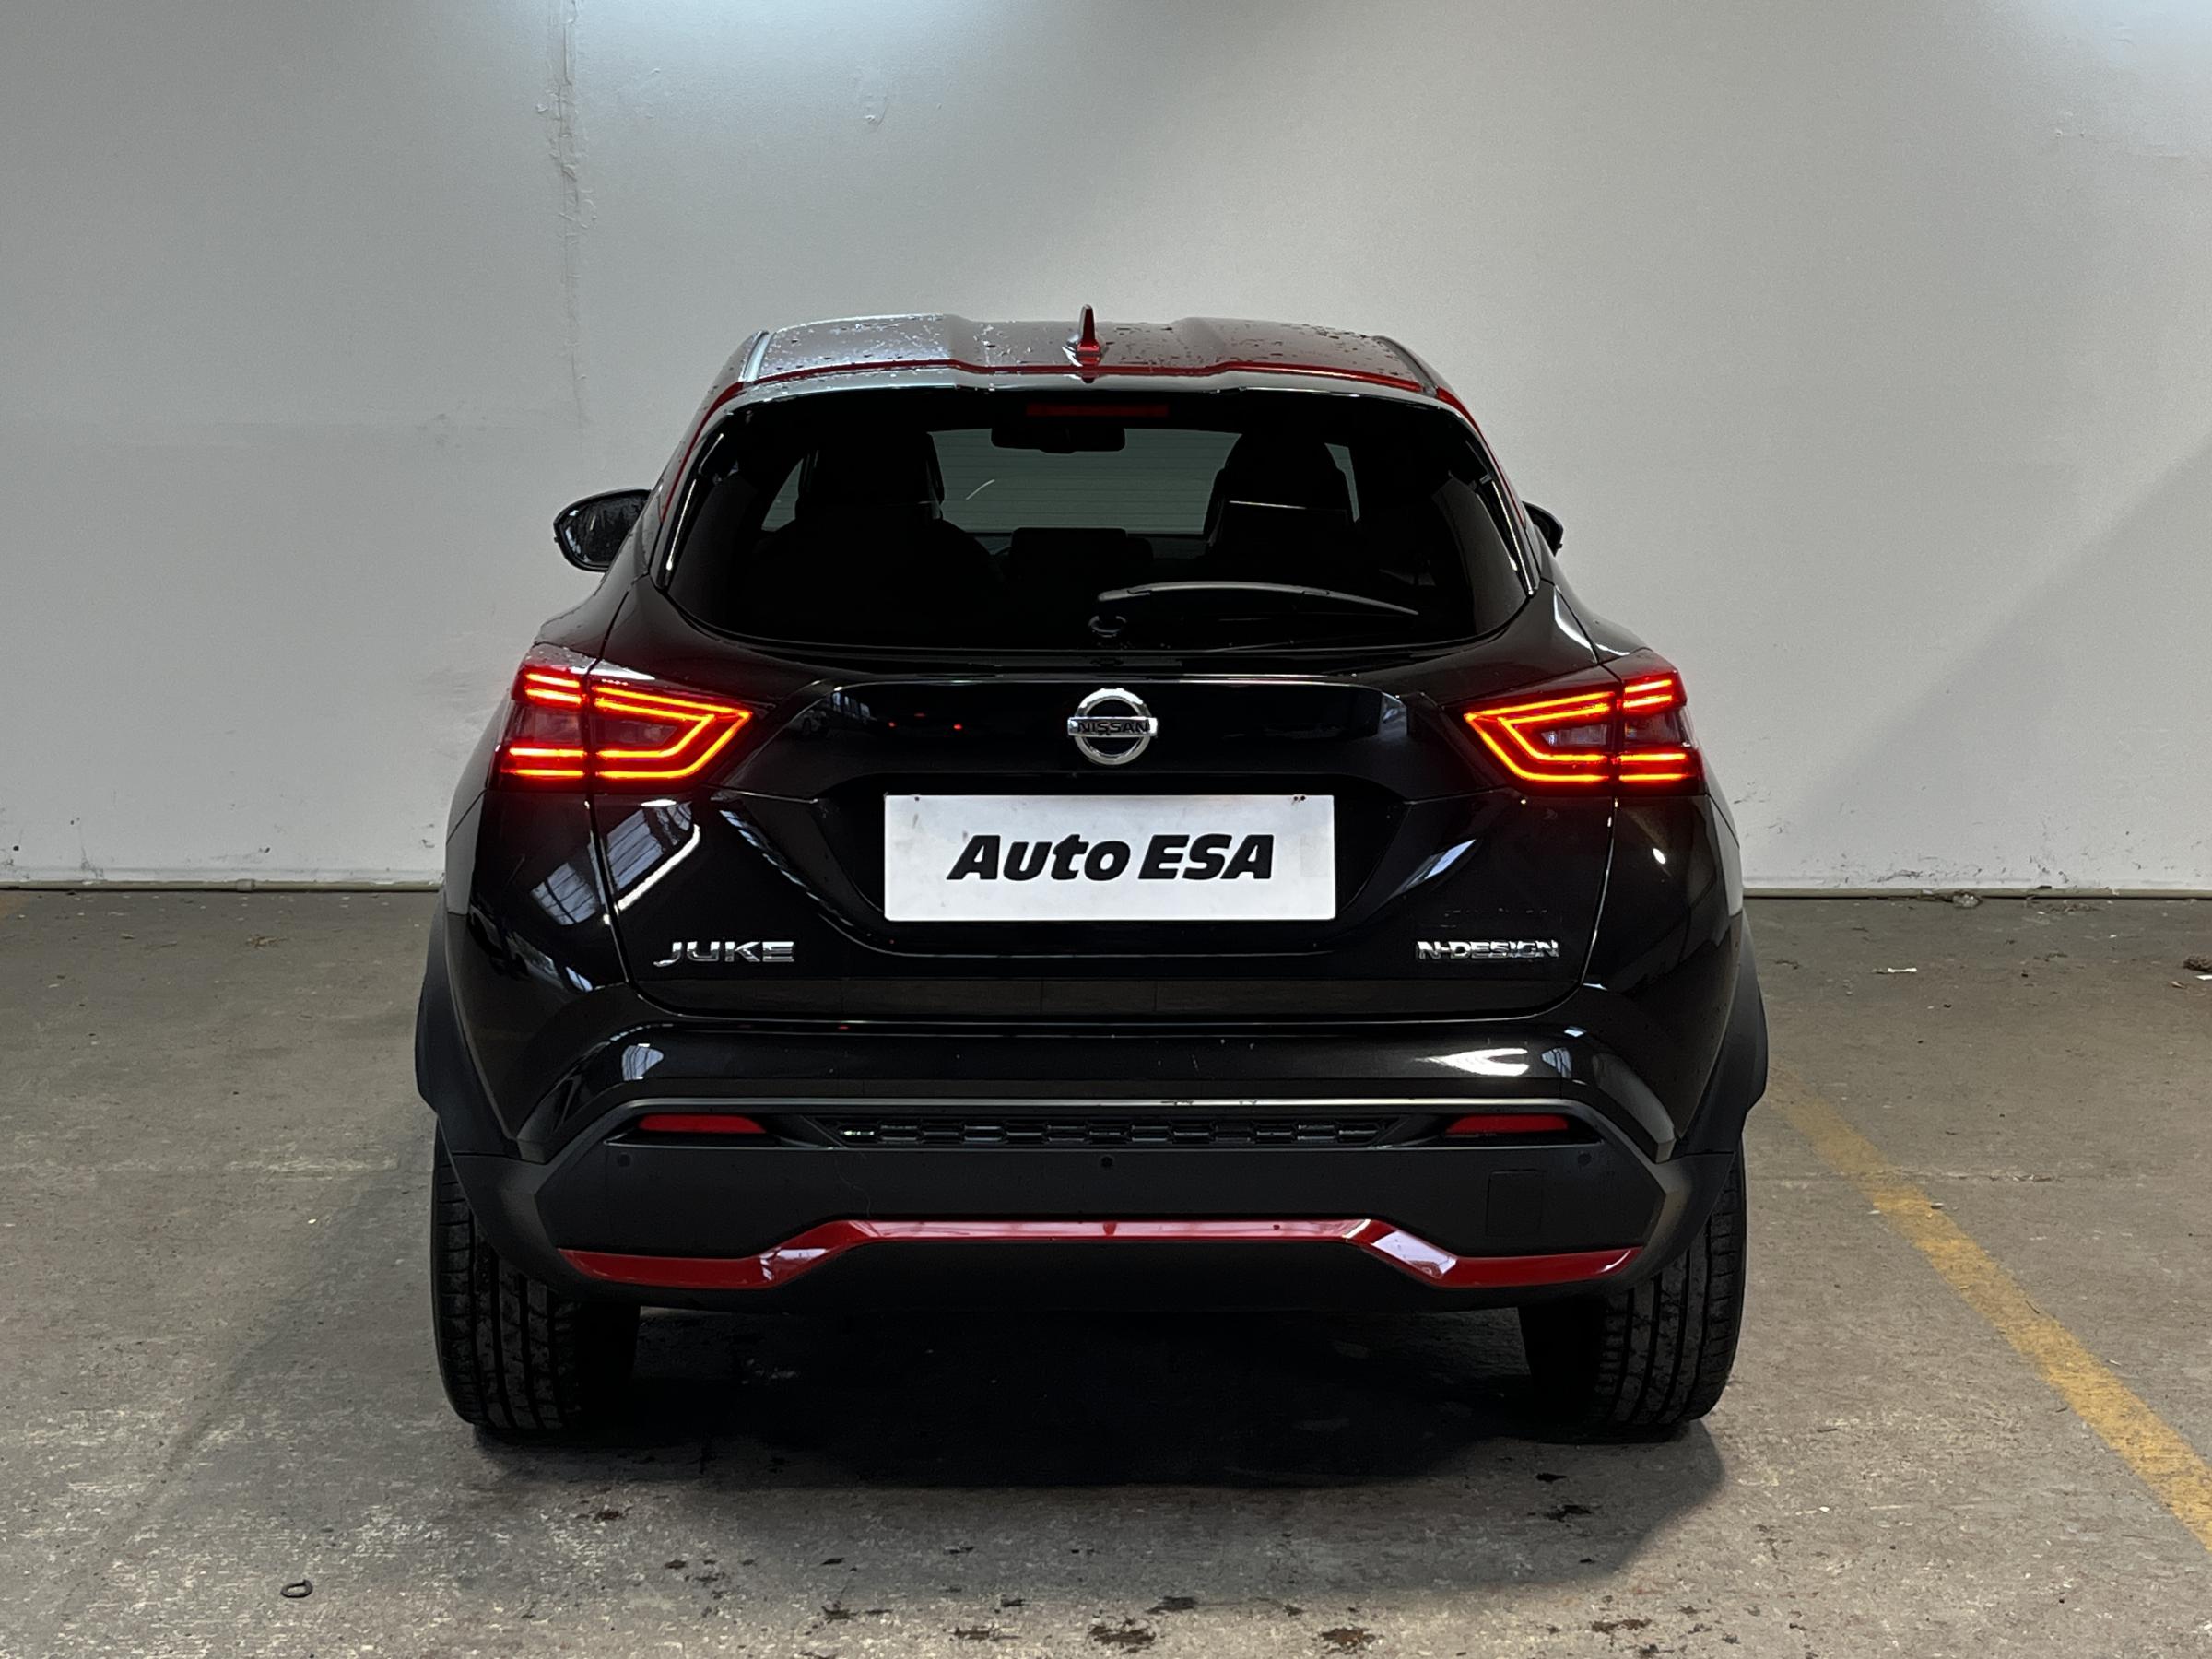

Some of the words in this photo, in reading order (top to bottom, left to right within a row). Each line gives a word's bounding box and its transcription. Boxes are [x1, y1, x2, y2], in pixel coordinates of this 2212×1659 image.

[1077, 721, 1151, 734] NISSAN
[946, 833, 1131, 881] Auto
[1137, 833, 1274, 880] ESA
[653, 941, 794, 967] JUKE
[1416, 940, 1559, 959] N-DESIGN
